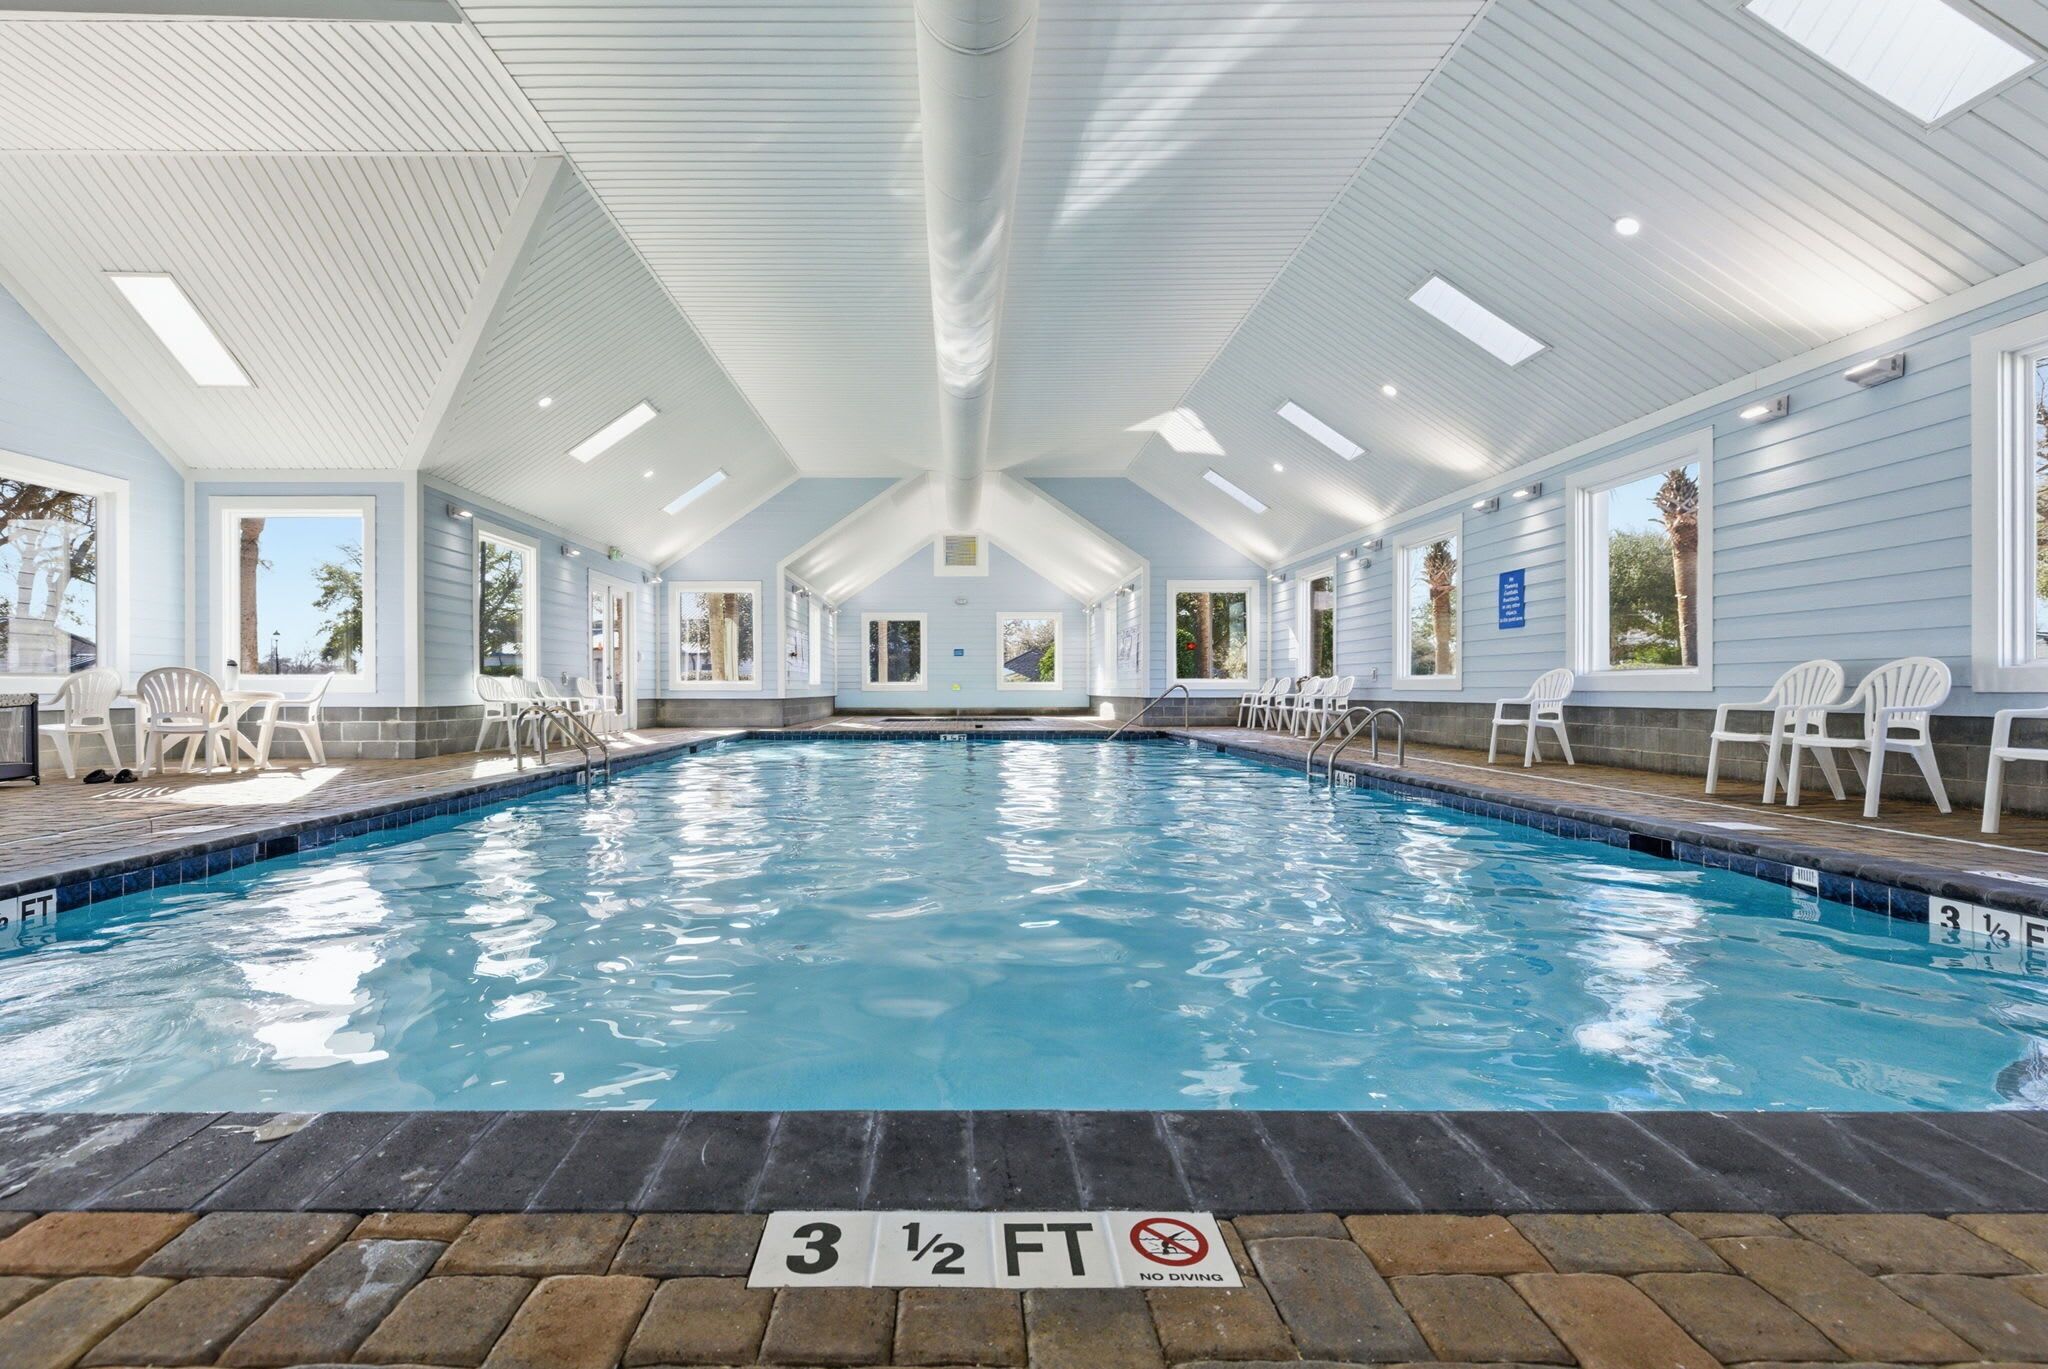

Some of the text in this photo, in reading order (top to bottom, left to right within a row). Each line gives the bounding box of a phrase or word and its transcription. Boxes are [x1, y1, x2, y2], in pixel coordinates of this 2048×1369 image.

[21, 894, 54, 921] FT
[1940, 905, 1961, 930] 3
[2026, 921, 2048, 948] F
[786, 1222, 1093, 1276] 3 1/2 FT
[1139, 1272, 1224, 1282] NO DIVING
